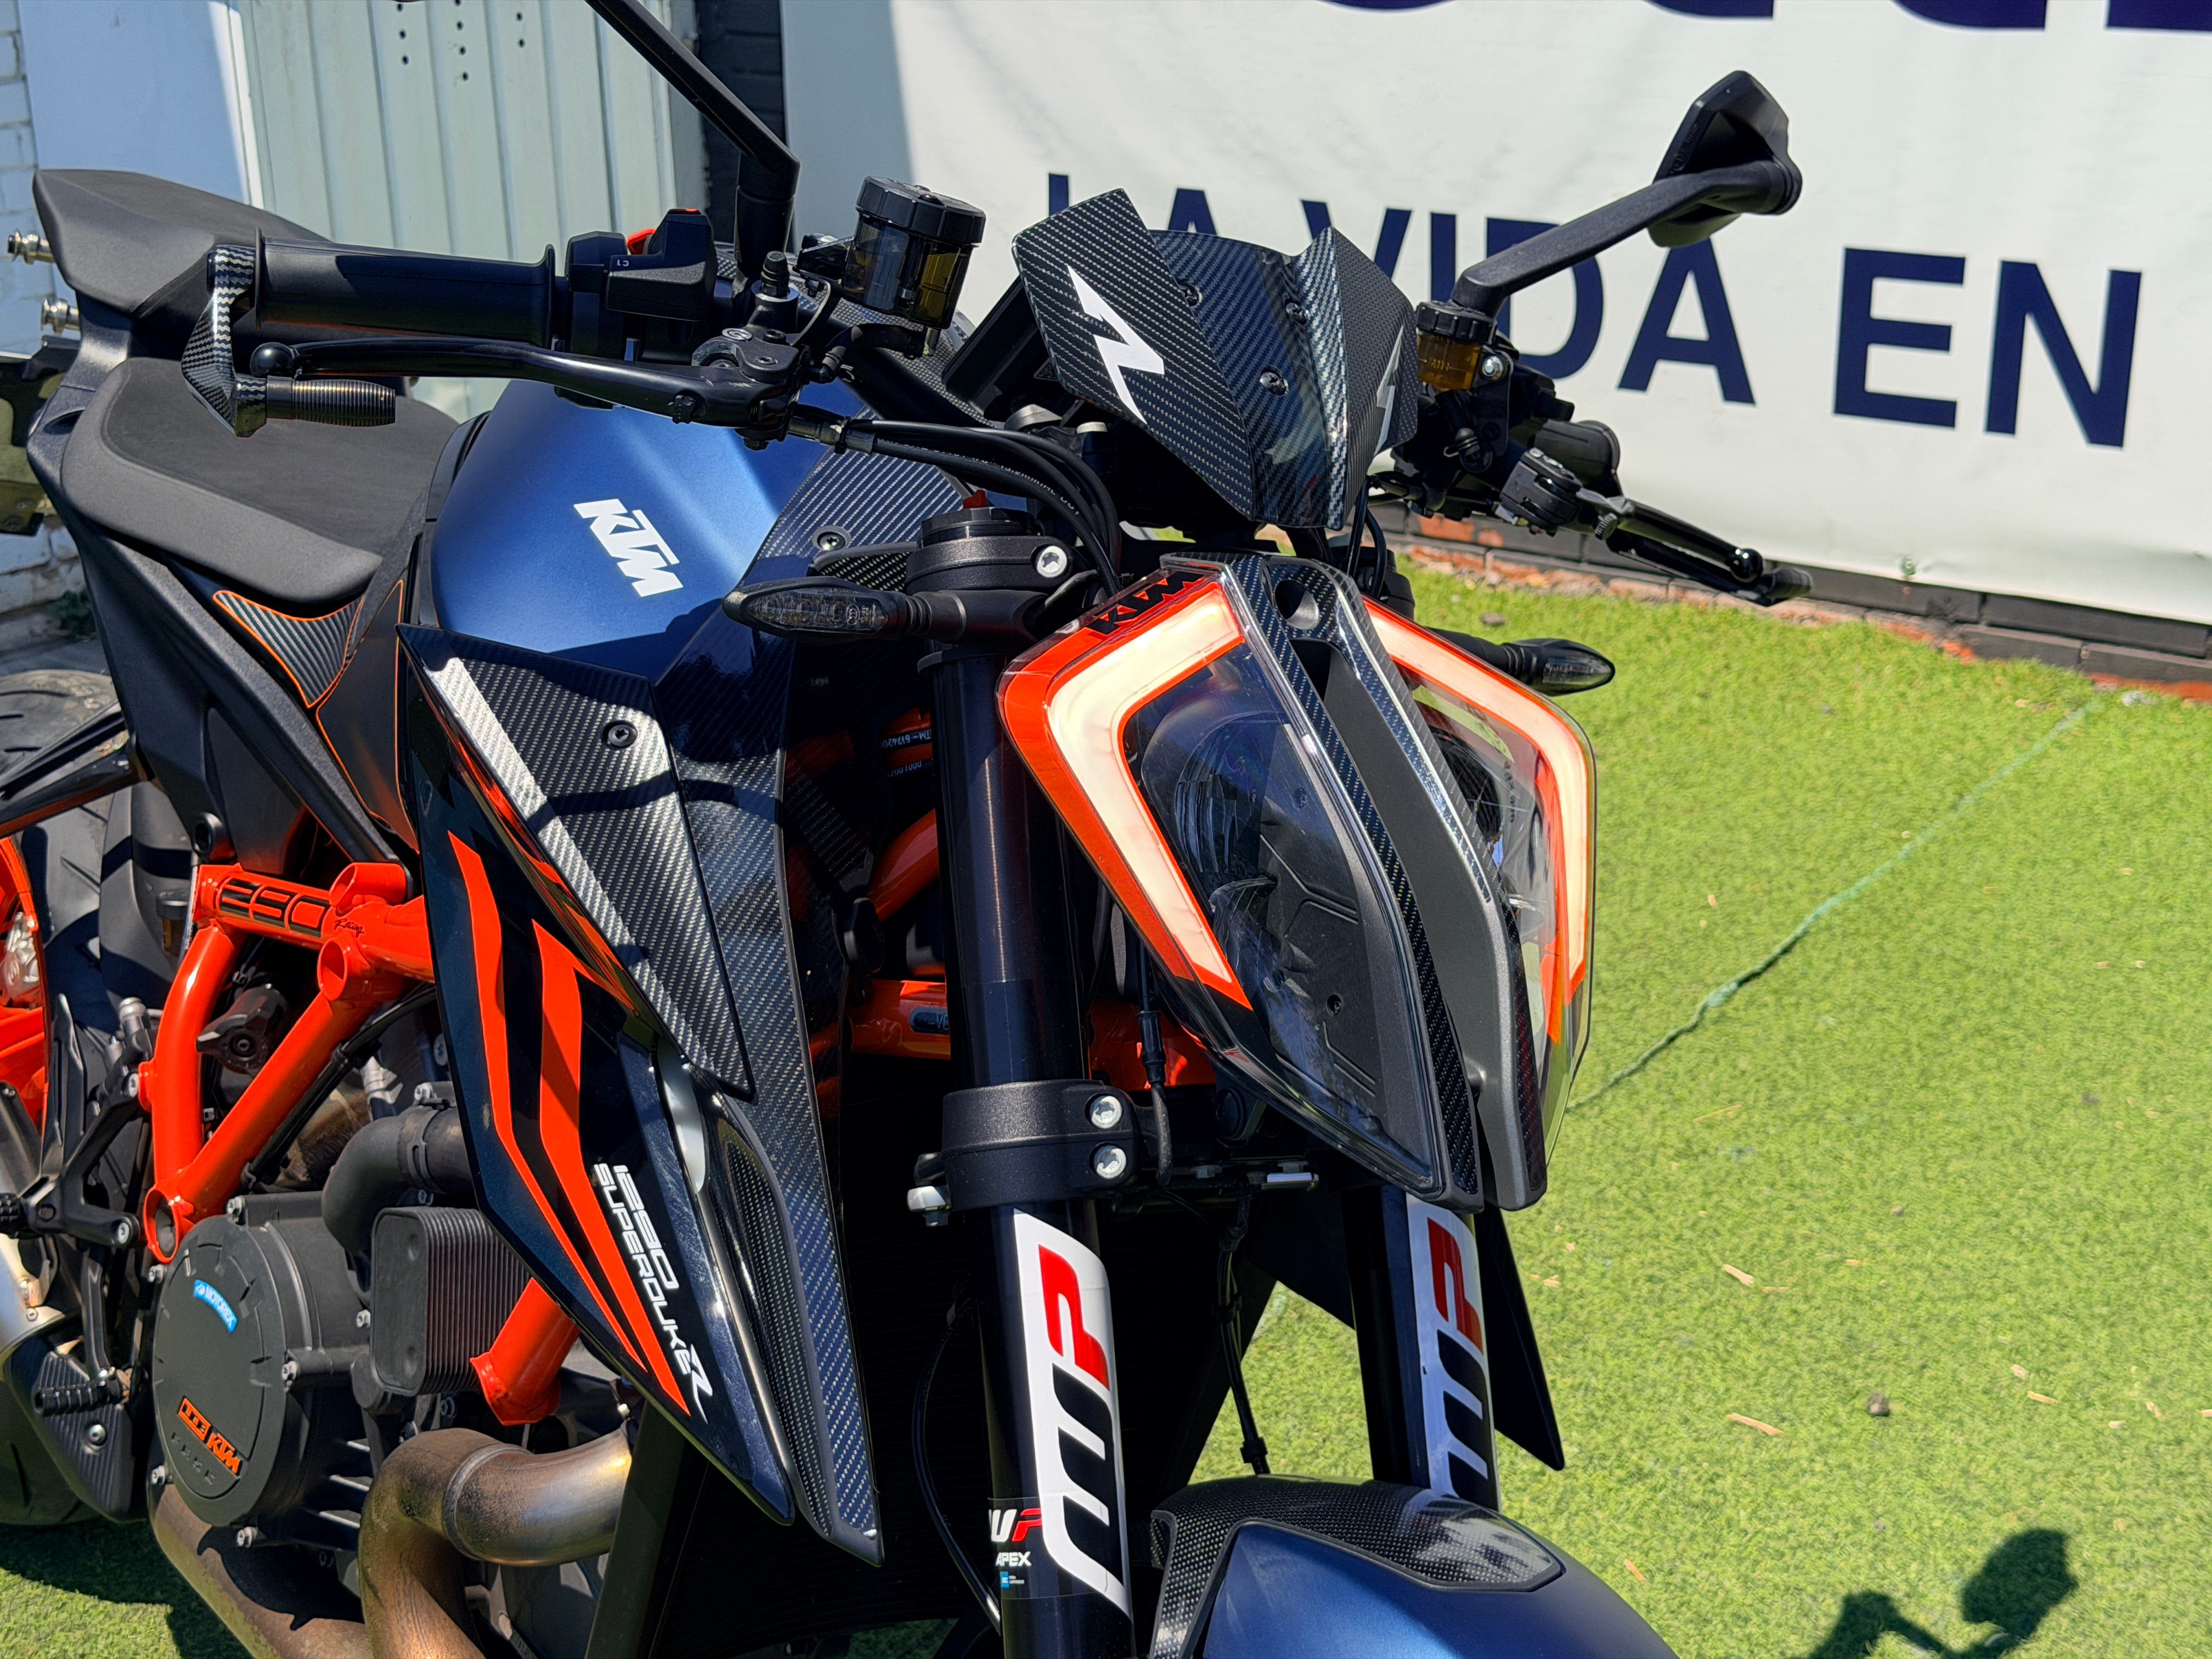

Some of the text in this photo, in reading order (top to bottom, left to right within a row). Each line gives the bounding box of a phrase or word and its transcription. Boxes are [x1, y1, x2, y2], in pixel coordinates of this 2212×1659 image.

[1832, 248, 2142, 447] EN
[573, 498, 684, 597] KTM
[1087, 571, 1206, 635] KTM
[593, 1163, 691, 1375] SUPERDUKE
[613, 1165, 680, 1290] 1290
[205, 1285, 234, 1327] MOTOREX
[206, 1432, 242, 1474] KTM
[1038, 1244, 1126, 1587] WP
[995, 1551, 1032, 1567] APEX
